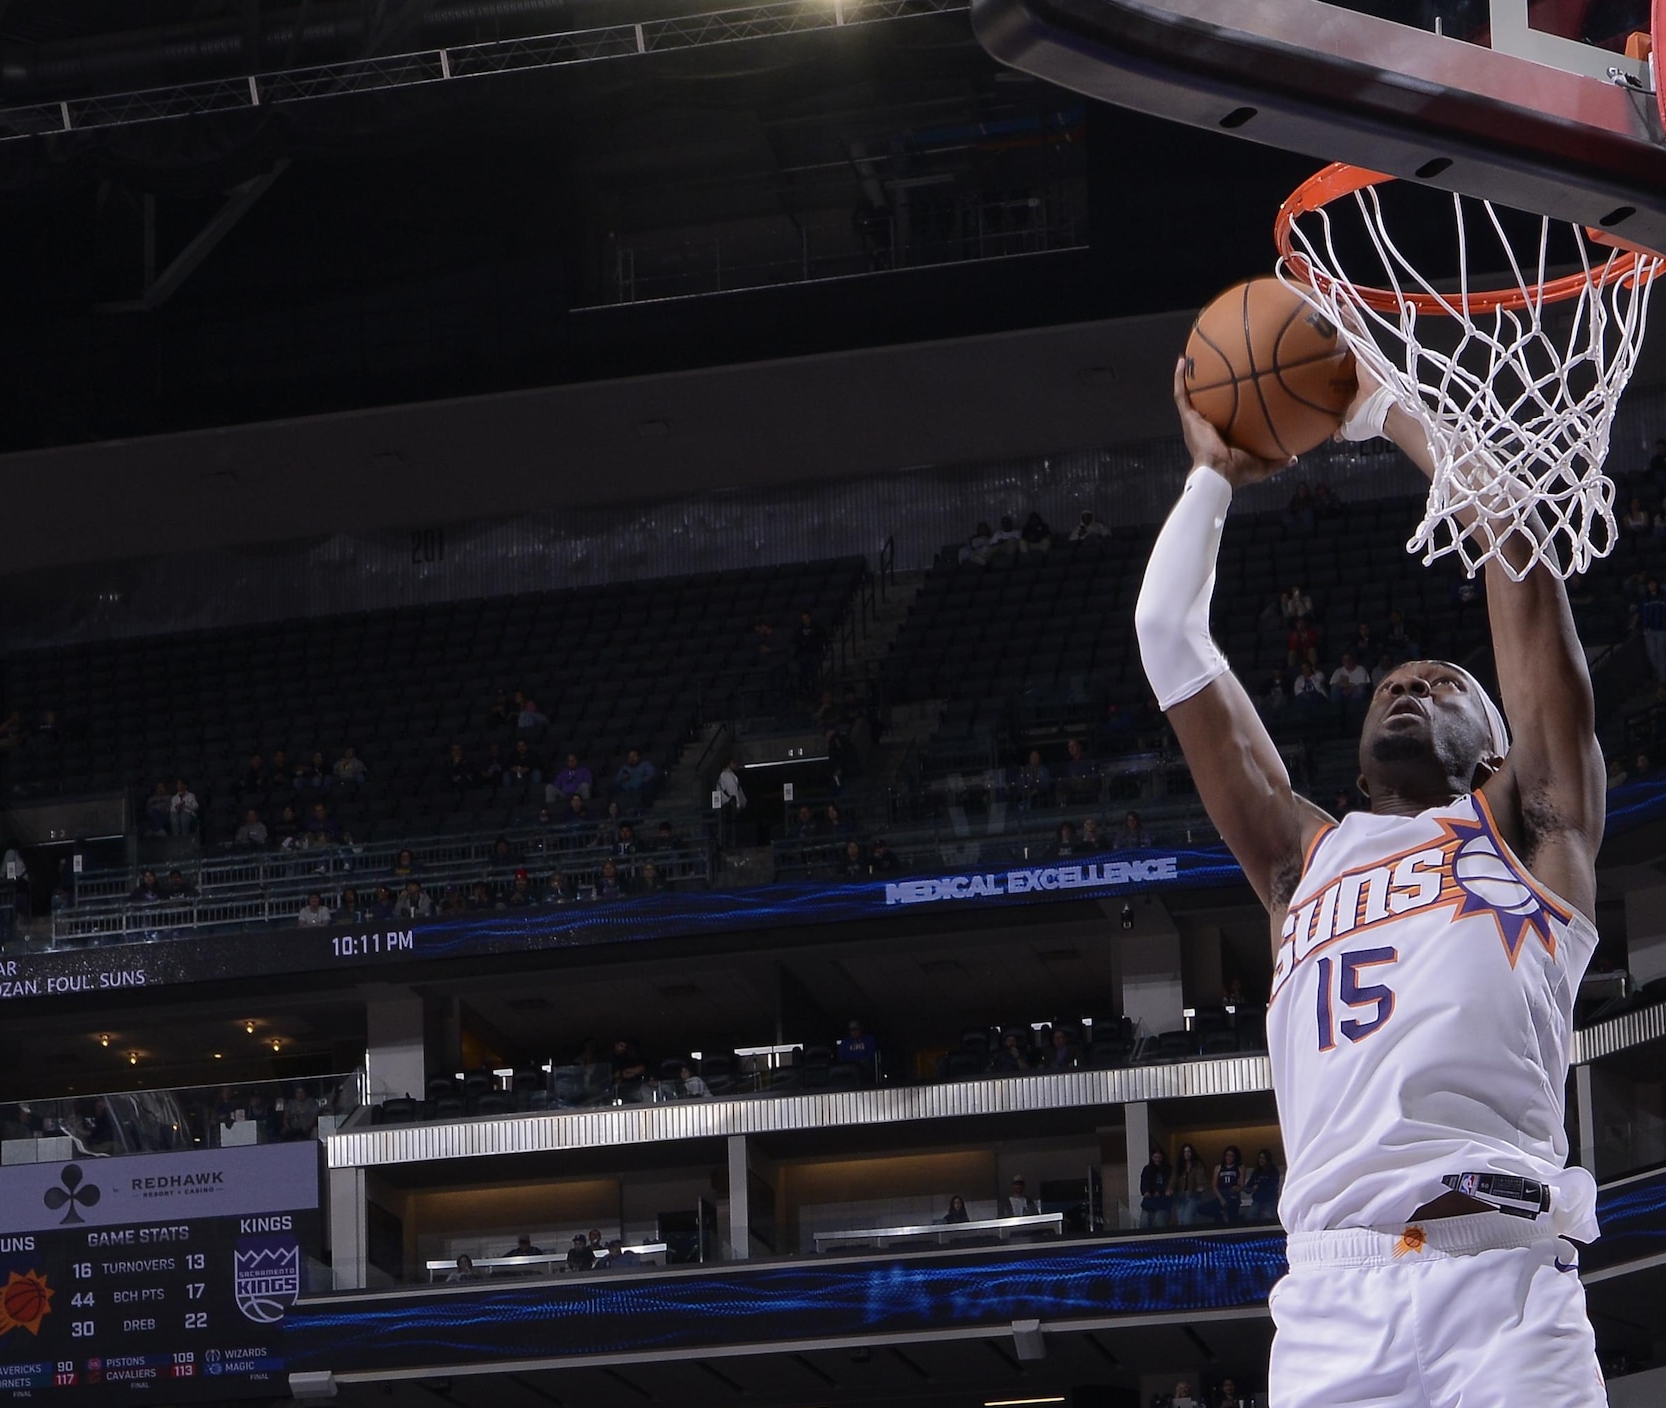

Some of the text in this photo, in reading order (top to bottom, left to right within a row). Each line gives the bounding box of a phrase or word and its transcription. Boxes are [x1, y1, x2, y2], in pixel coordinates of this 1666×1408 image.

[885, 857, 1177, 905] MEDICAL EXCELLENCE
[1273, 848, 1445, 998] SUNS
[332, 930, 413, 956] 10:11 PM
[100, 968, 146, 988] SUNS
[1317, 946, 1398, 1053] 15
[131, 1171, 225, 1191] REDHAWK
[142, 1186, 215, 1199] RESORT CASINO
[240, 1215, 292, 1235] KINGS
[88, 1226, 190, 1248] GAME STATS
[73, 1254, 205, 1279] 16 TURNOVERS 13
[238, 1267, 296, 1278] SACRAMENTO
[71, 1283, 205, 1308] 44 BCH PTS 17
[237, 1277, 298, 1296] KINGS
[71, 1312, 208, 1337] 30 DREB 22
[105, 1351, 195, 1368] PISTONS 109
[224, 1347, 268, 1359] WIZARDS
[57, 1360, 73, 1373] 90
[105, 1364, 194, 1381] CAVALIERS 113
[224, 1361, 255, 1373] MAGIC
[56, 1373, 75, 1386] 117
[130, 1381, 150, 1390] FINAL
[249, 1372, 269, 1381] FINAL
[12, 1390, 32, 1398] FINAL
